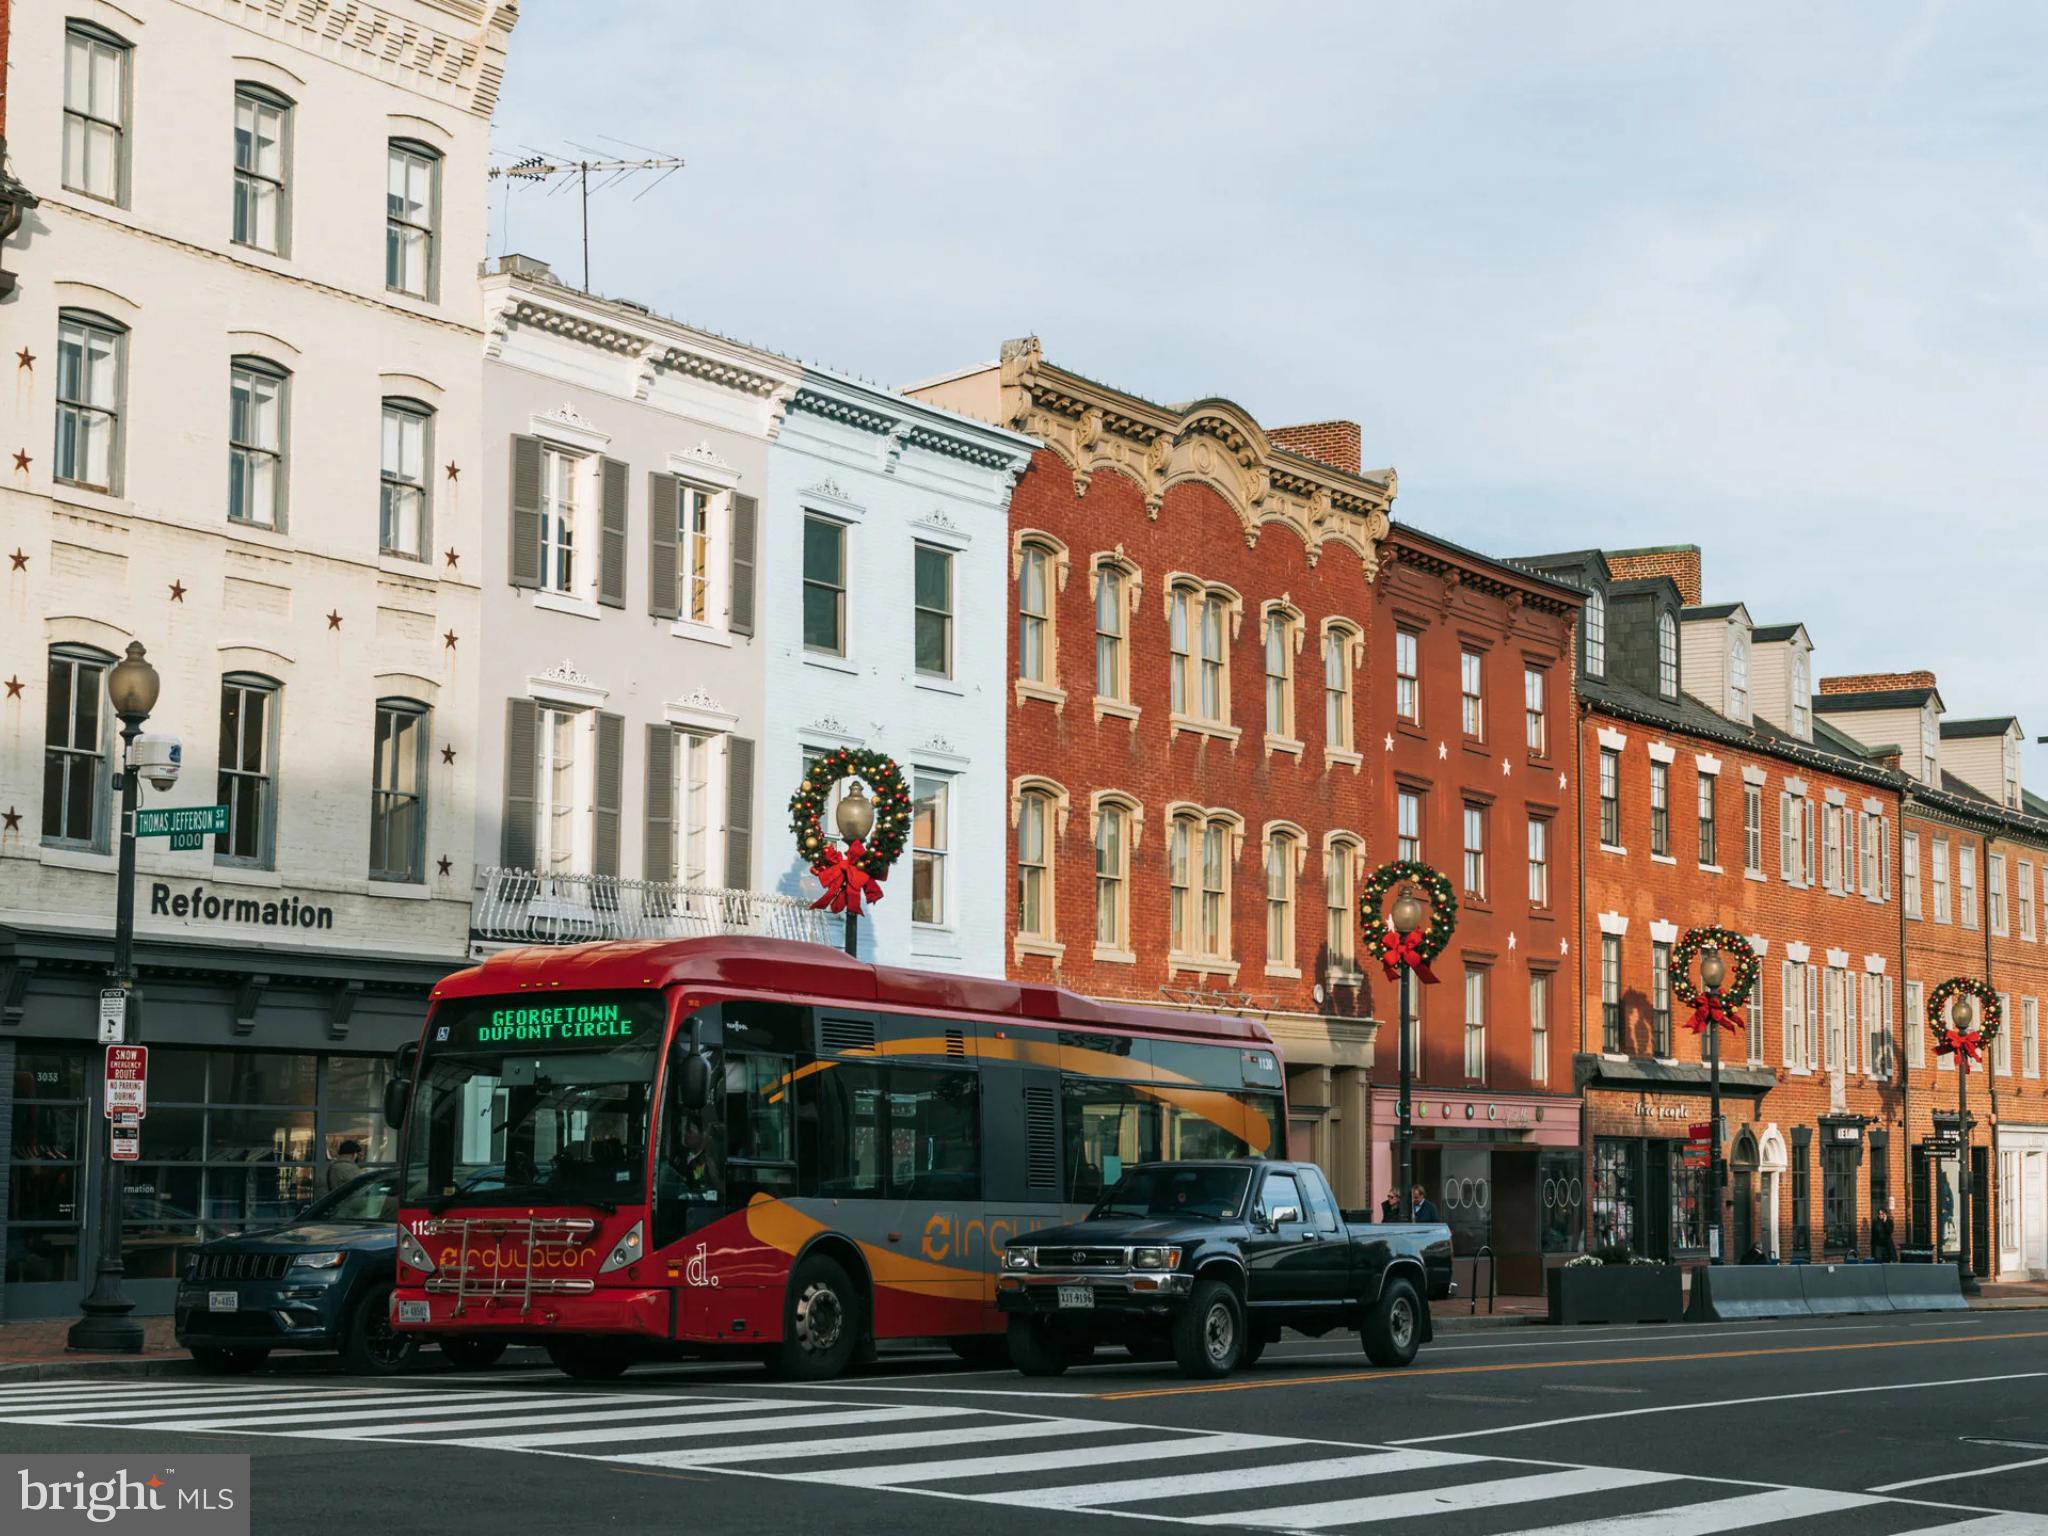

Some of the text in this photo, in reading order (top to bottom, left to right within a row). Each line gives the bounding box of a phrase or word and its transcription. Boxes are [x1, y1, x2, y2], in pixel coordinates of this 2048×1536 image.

[216, 809, 224, 819] ST
[140, 811, 213, 833] THOMAS JEFFERSON
[215, 820, 225, 829] NW
[173, 833, 201, 848] 1000
[151, 883, 333, 929] Reformation
[493, 1005, 619, 1027] GEORGETOWN
[479, 1020, 632, 1042] DUPONT CIRCLE
[115, 1049, 138, 1061] SNOW
[110, 1060, 142, 1070] EMERGENCY
[115, 1069, 137, 1080] ROUTE
[110, 1081, 141, 1091] NO PARKING
[114, 1091, 137, 1101] DURING
[124, 1184, 155, 1194] rmation
[440, 1243, 596, 1268] crculator
